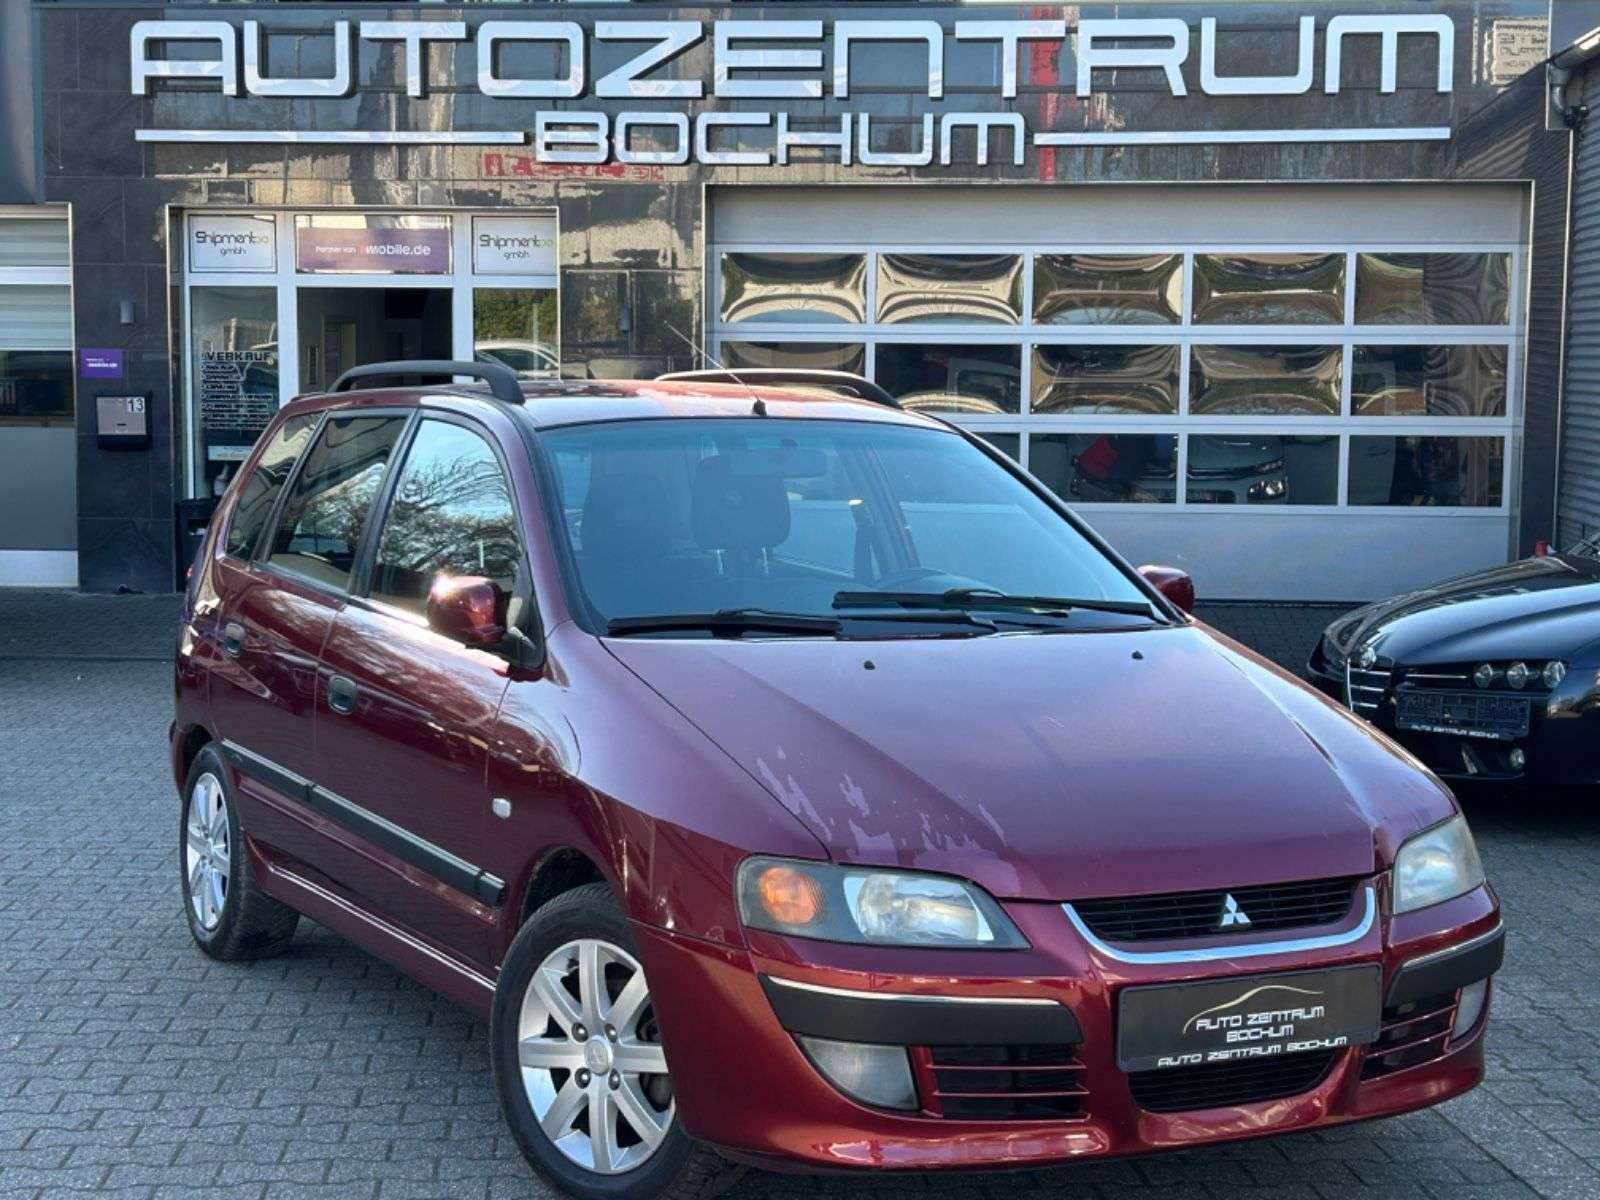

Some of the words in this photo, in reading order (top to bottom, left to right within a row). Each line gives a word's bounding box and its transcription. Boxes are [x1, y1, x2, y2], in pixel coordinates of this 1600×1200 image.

[130, 13, 1455, 99] AUTOZENTRUM
[534, 110, 1026, 166] BOCHUM
[365, 243, 432, 256] mobile.de
[128, 399, 144, 412] 13
[1196, 1015, 1243, 1031] AUTO
[1247, 1006, 1325, 1026] ZENTRUM
[1226, 1023, 1295, 1043] BOCHUM
[1157, 1053, 1203, 1067] AUTO
[1207, 1043, 1283, 1061] ZENTRUM
[1286, 1035, 1348, 1052] BOCHUM
